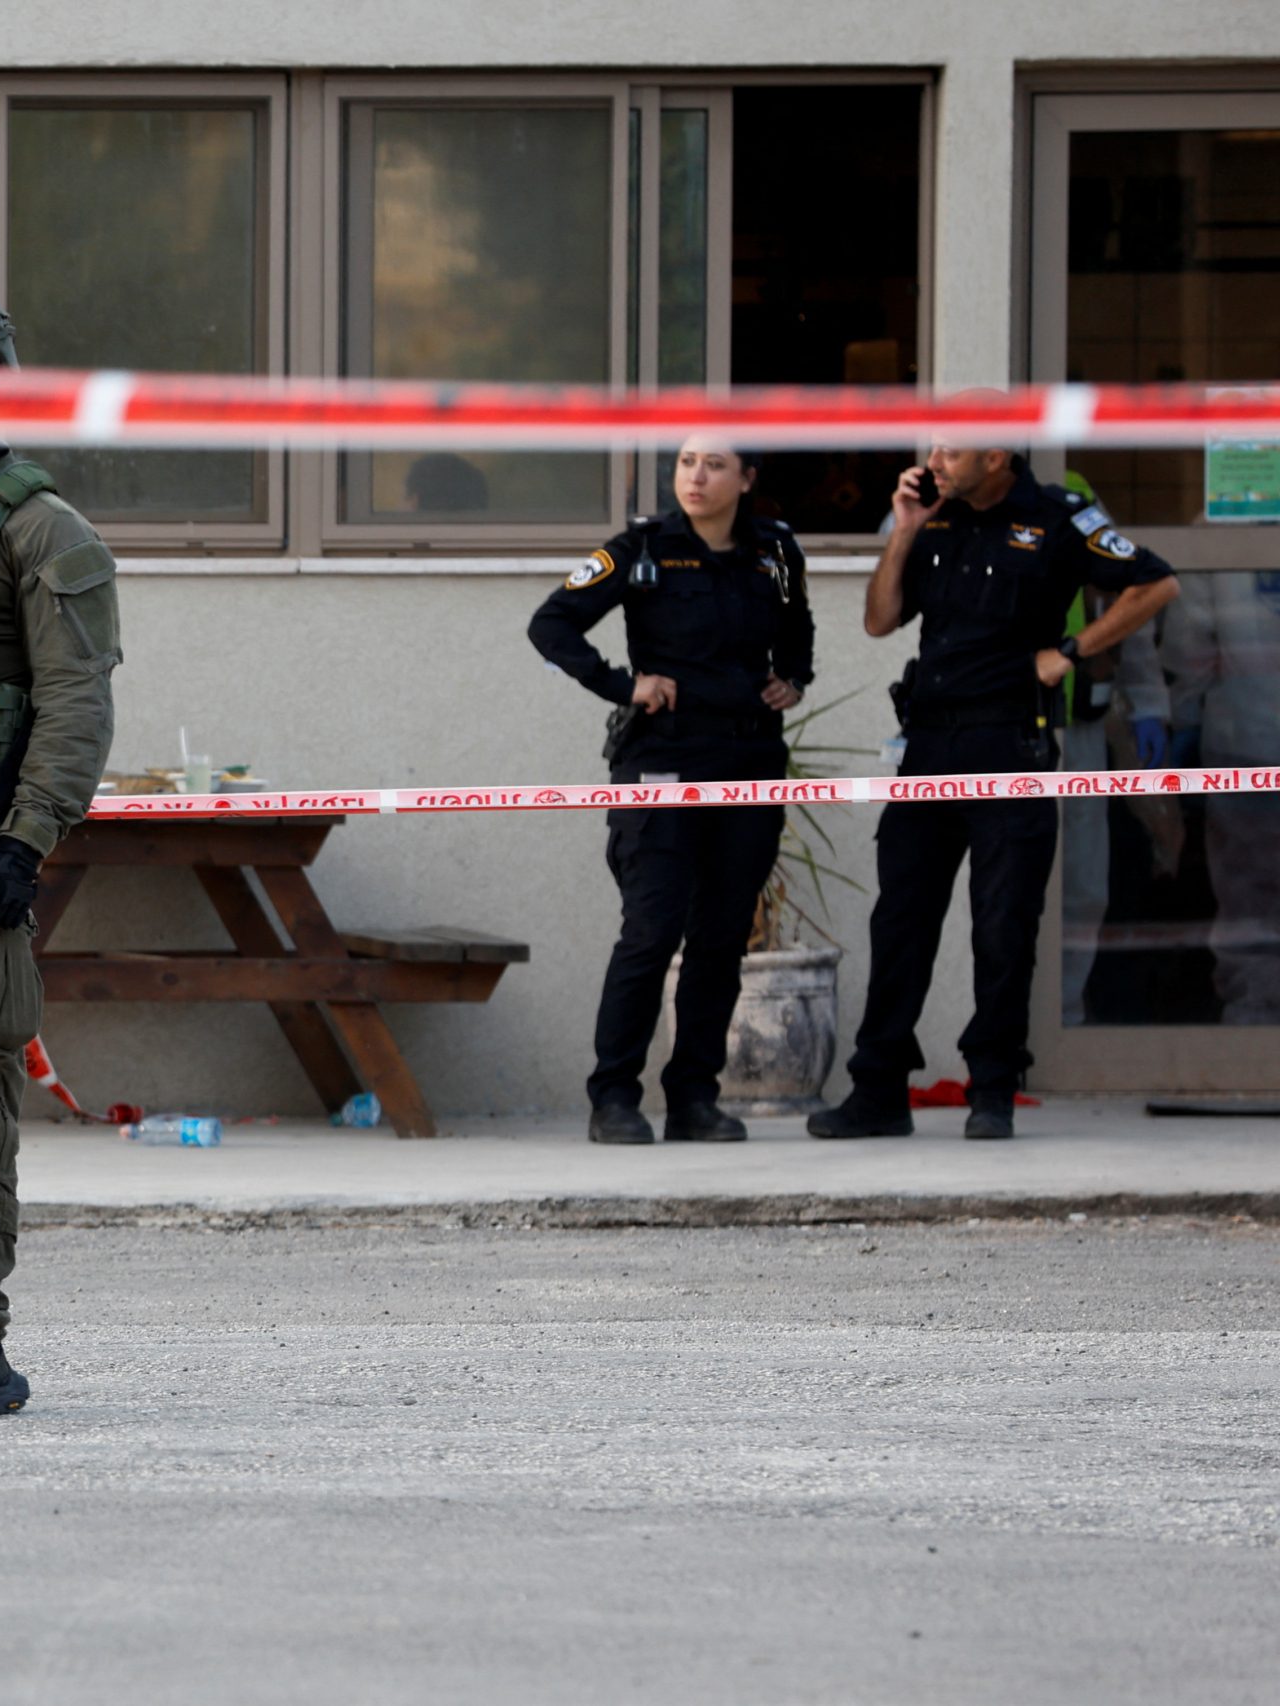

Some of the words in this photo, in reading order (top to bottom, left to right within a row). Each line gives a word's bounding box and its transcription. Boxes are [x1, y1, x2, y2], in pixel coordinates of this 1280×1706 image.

[721, 783, 758, 801] אין
[768, 783, 844, 801] מעבר
[889, 780, 997, 799] משטרת
[1058, 776, 1145, 795] ישראל
[1202, 770, 1239, 790] אין
